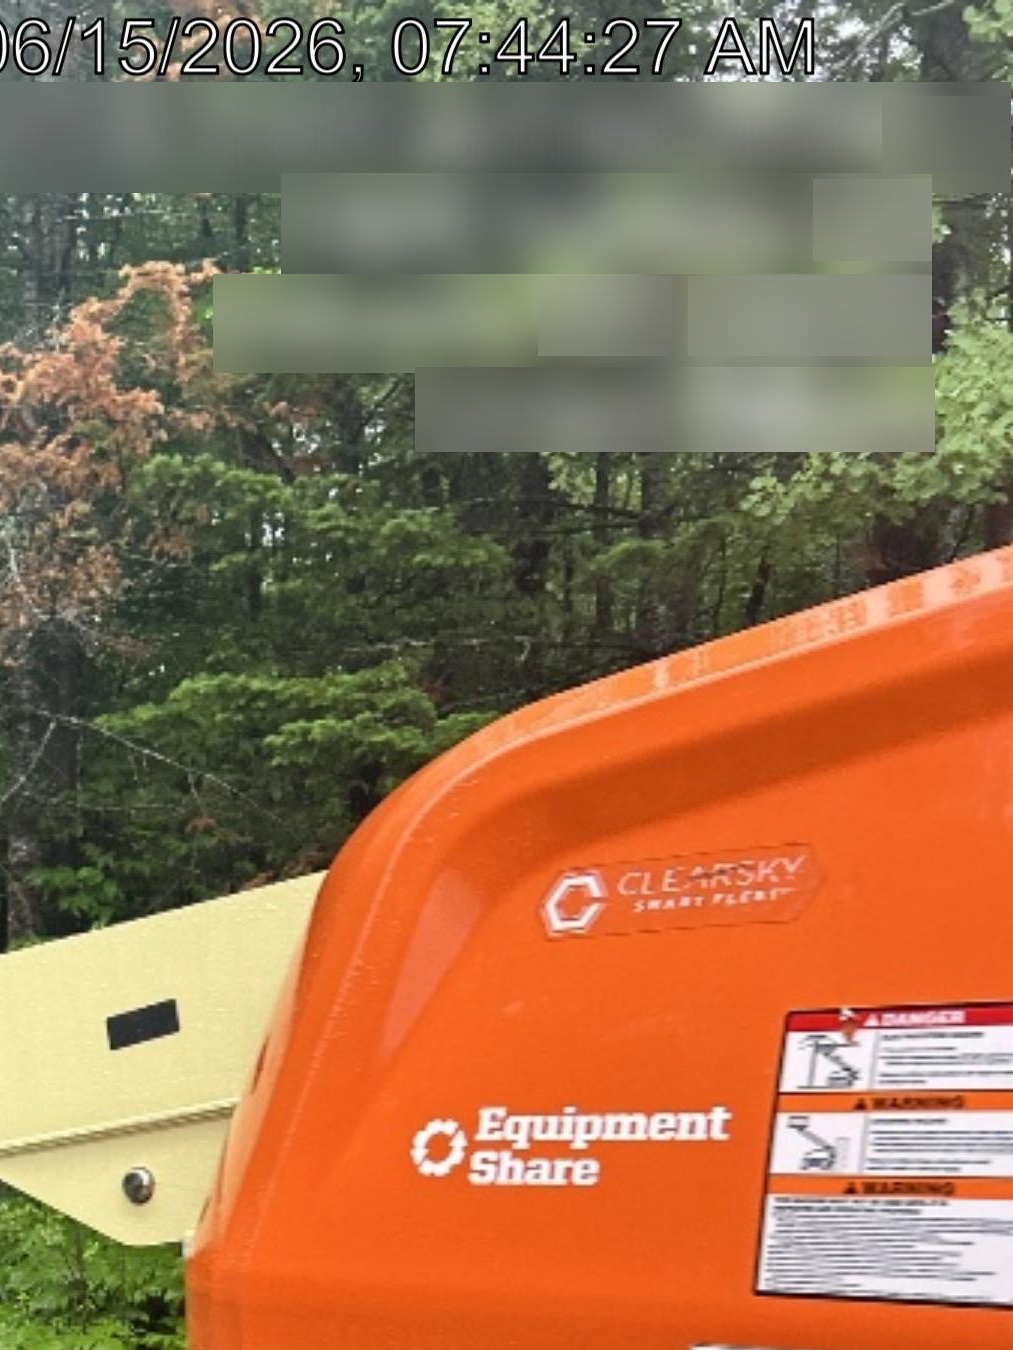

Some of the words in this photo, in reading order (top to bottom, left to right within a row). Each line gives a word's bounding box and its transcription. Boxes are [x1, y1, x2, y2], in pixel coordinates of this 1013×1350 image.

[617, 855, 806, 895] CLEARSKY
[881, 1011, 966, 1026] DANGER
[872, 1095, 965, 1110] WARNING
[475, 1106, 732, 1149] Equipment
[468, 1150, 600, 1186] Share
[862, 1181, 956, 1196] WARNING
